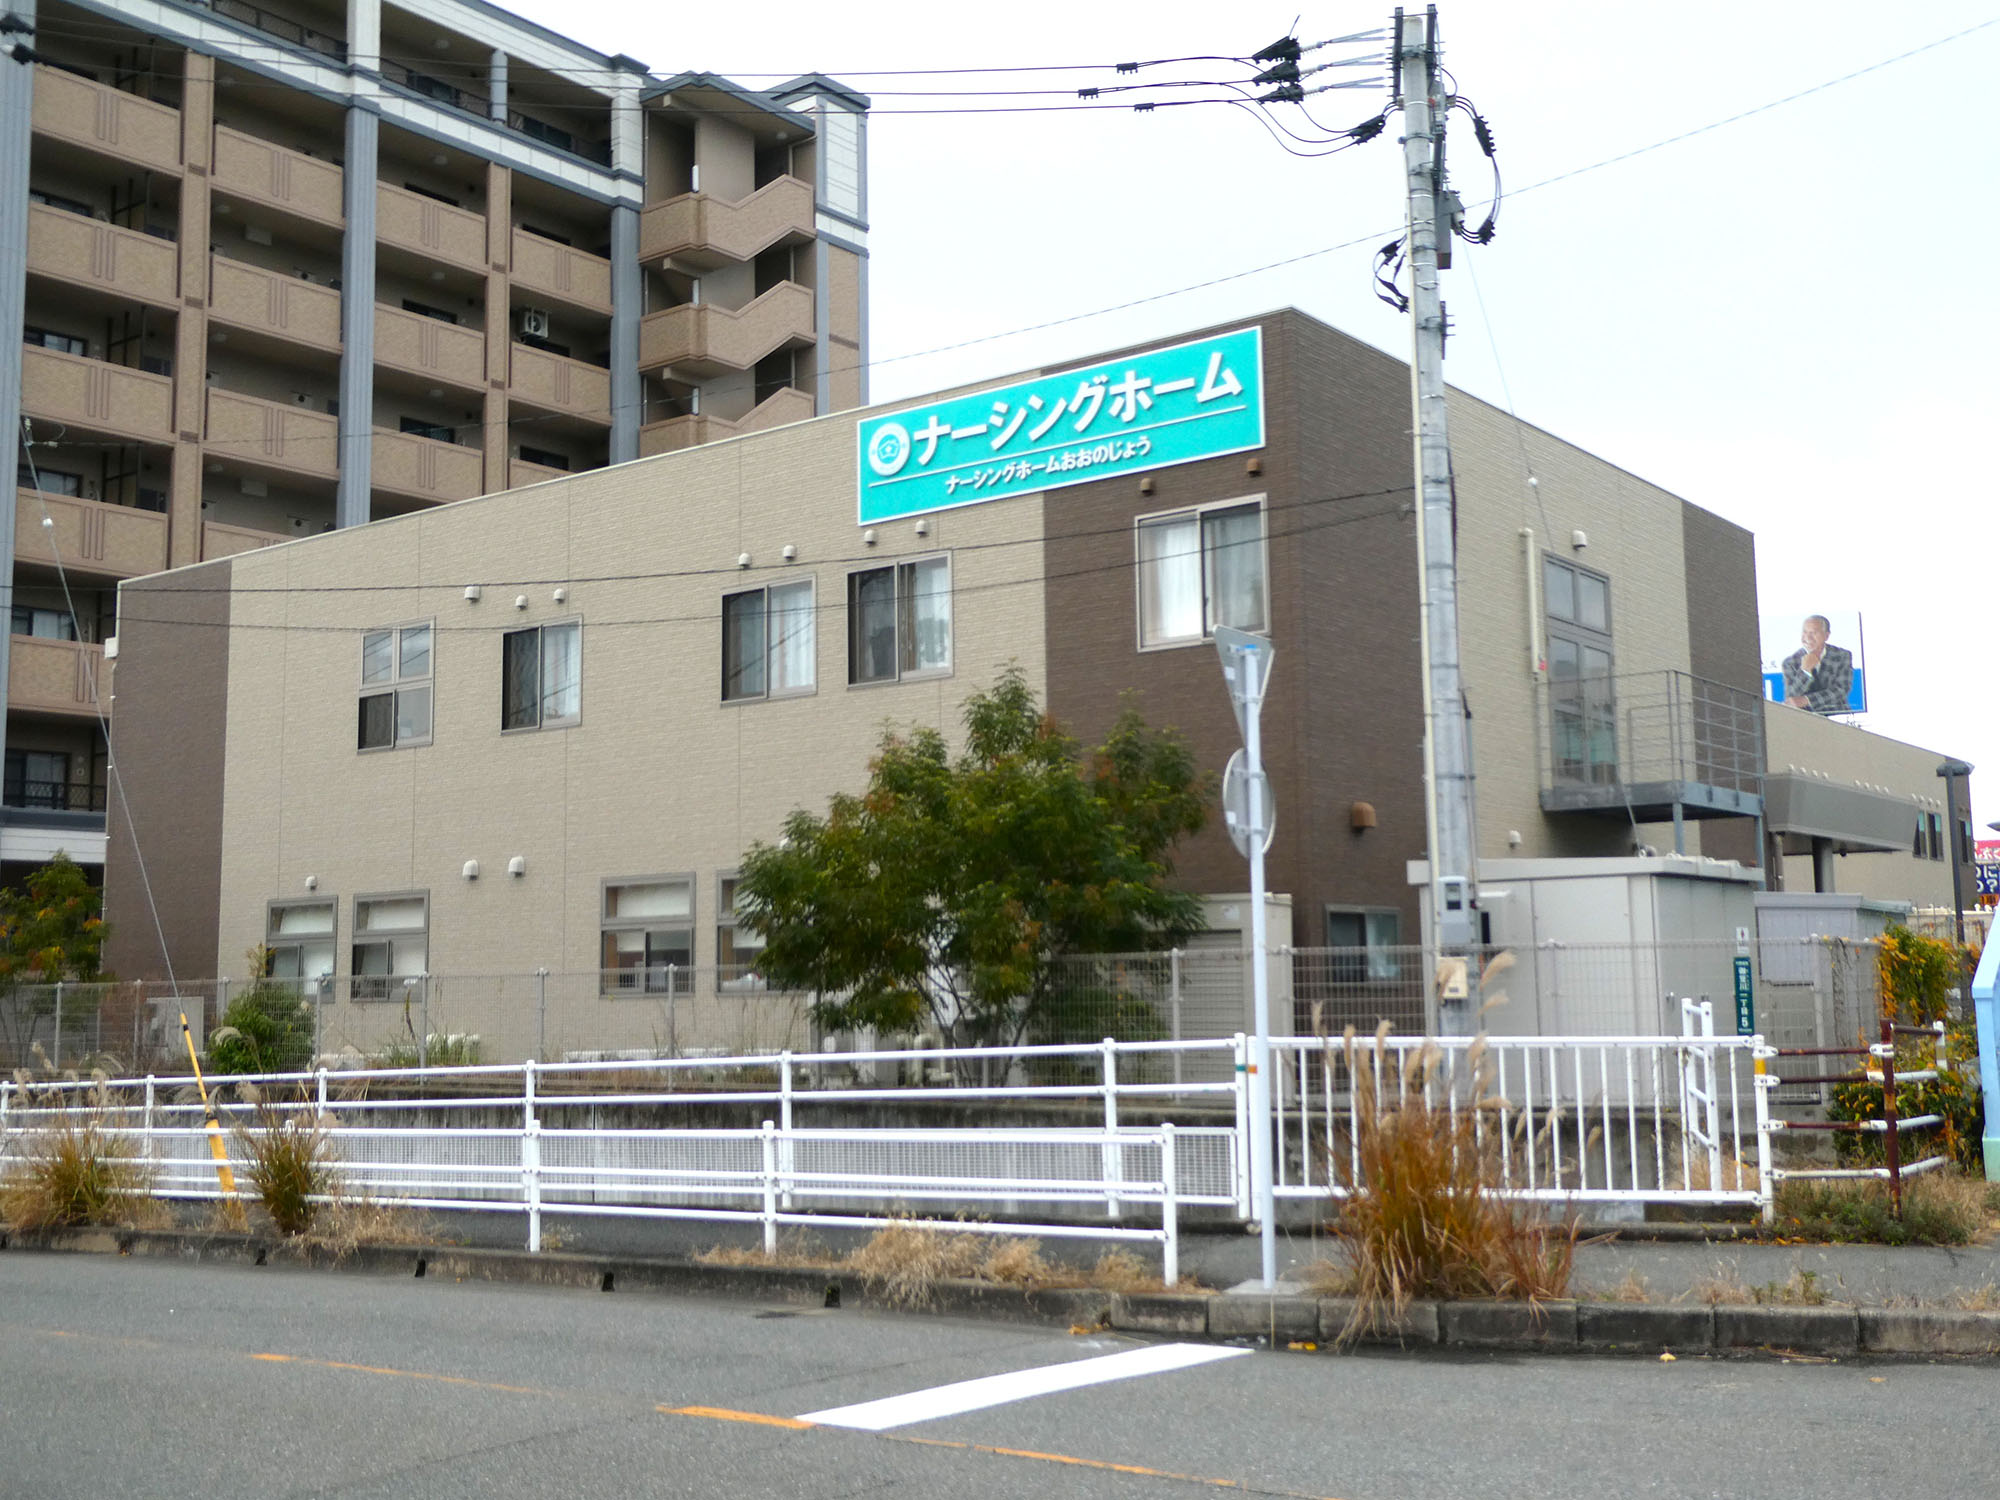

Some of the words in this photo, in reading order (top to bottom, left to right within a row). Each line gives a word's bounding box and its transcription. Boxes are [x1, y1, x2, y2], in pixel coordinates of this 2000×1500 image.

[913, 351, 1243, 466] ナーシングホーム
[945, 435, 1153, 495] ナーシングホームおおのじょう
